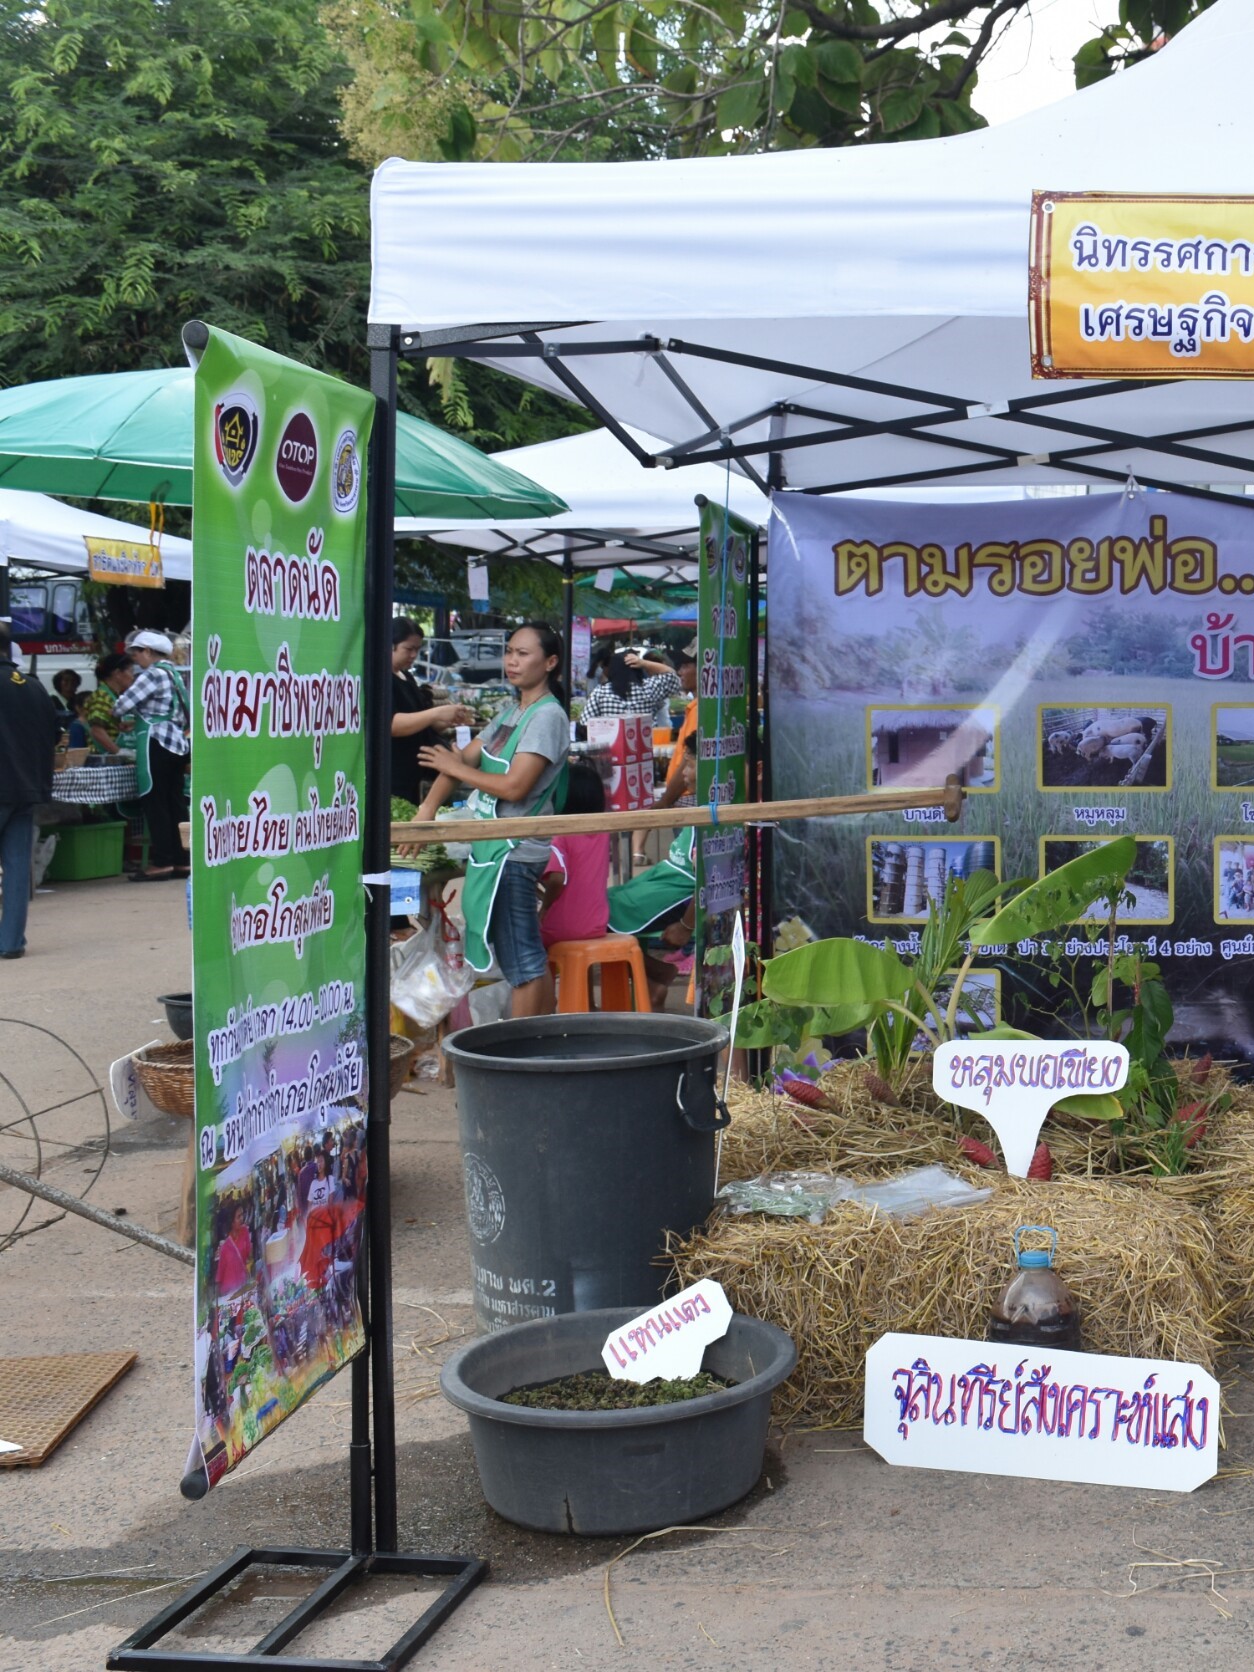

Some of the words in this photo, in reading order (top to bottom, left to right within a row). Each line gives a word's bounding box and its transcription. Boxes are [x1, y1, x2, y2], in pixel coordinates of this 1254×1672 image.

[282, 440, 314, 466] OTOP
[246, 529, 339, 619] ตลาดนัด
[203, 637, 361, 766] สัมมาชีพชุมชน
[202, 792, 291, 864] ไทยช่วยไทย
[294, 772, 359, 851] คนไทยยิ้มได้
[1074, 806, 1125, 826] หมูหลุม
[231, 874, 335, 957] อำเภอโกสุมพิสัย
[1159, 940, 1172, 956] 4
[1174, 938, 1212, 956] อย่าง
[949, 1047, 1123, 1105] หลุมพอเพียง
[200, 1125, 216, 1170] ณ
[891, 1357, 1210, 1450] จุลินทรีย์สังเคราะห์แสง
